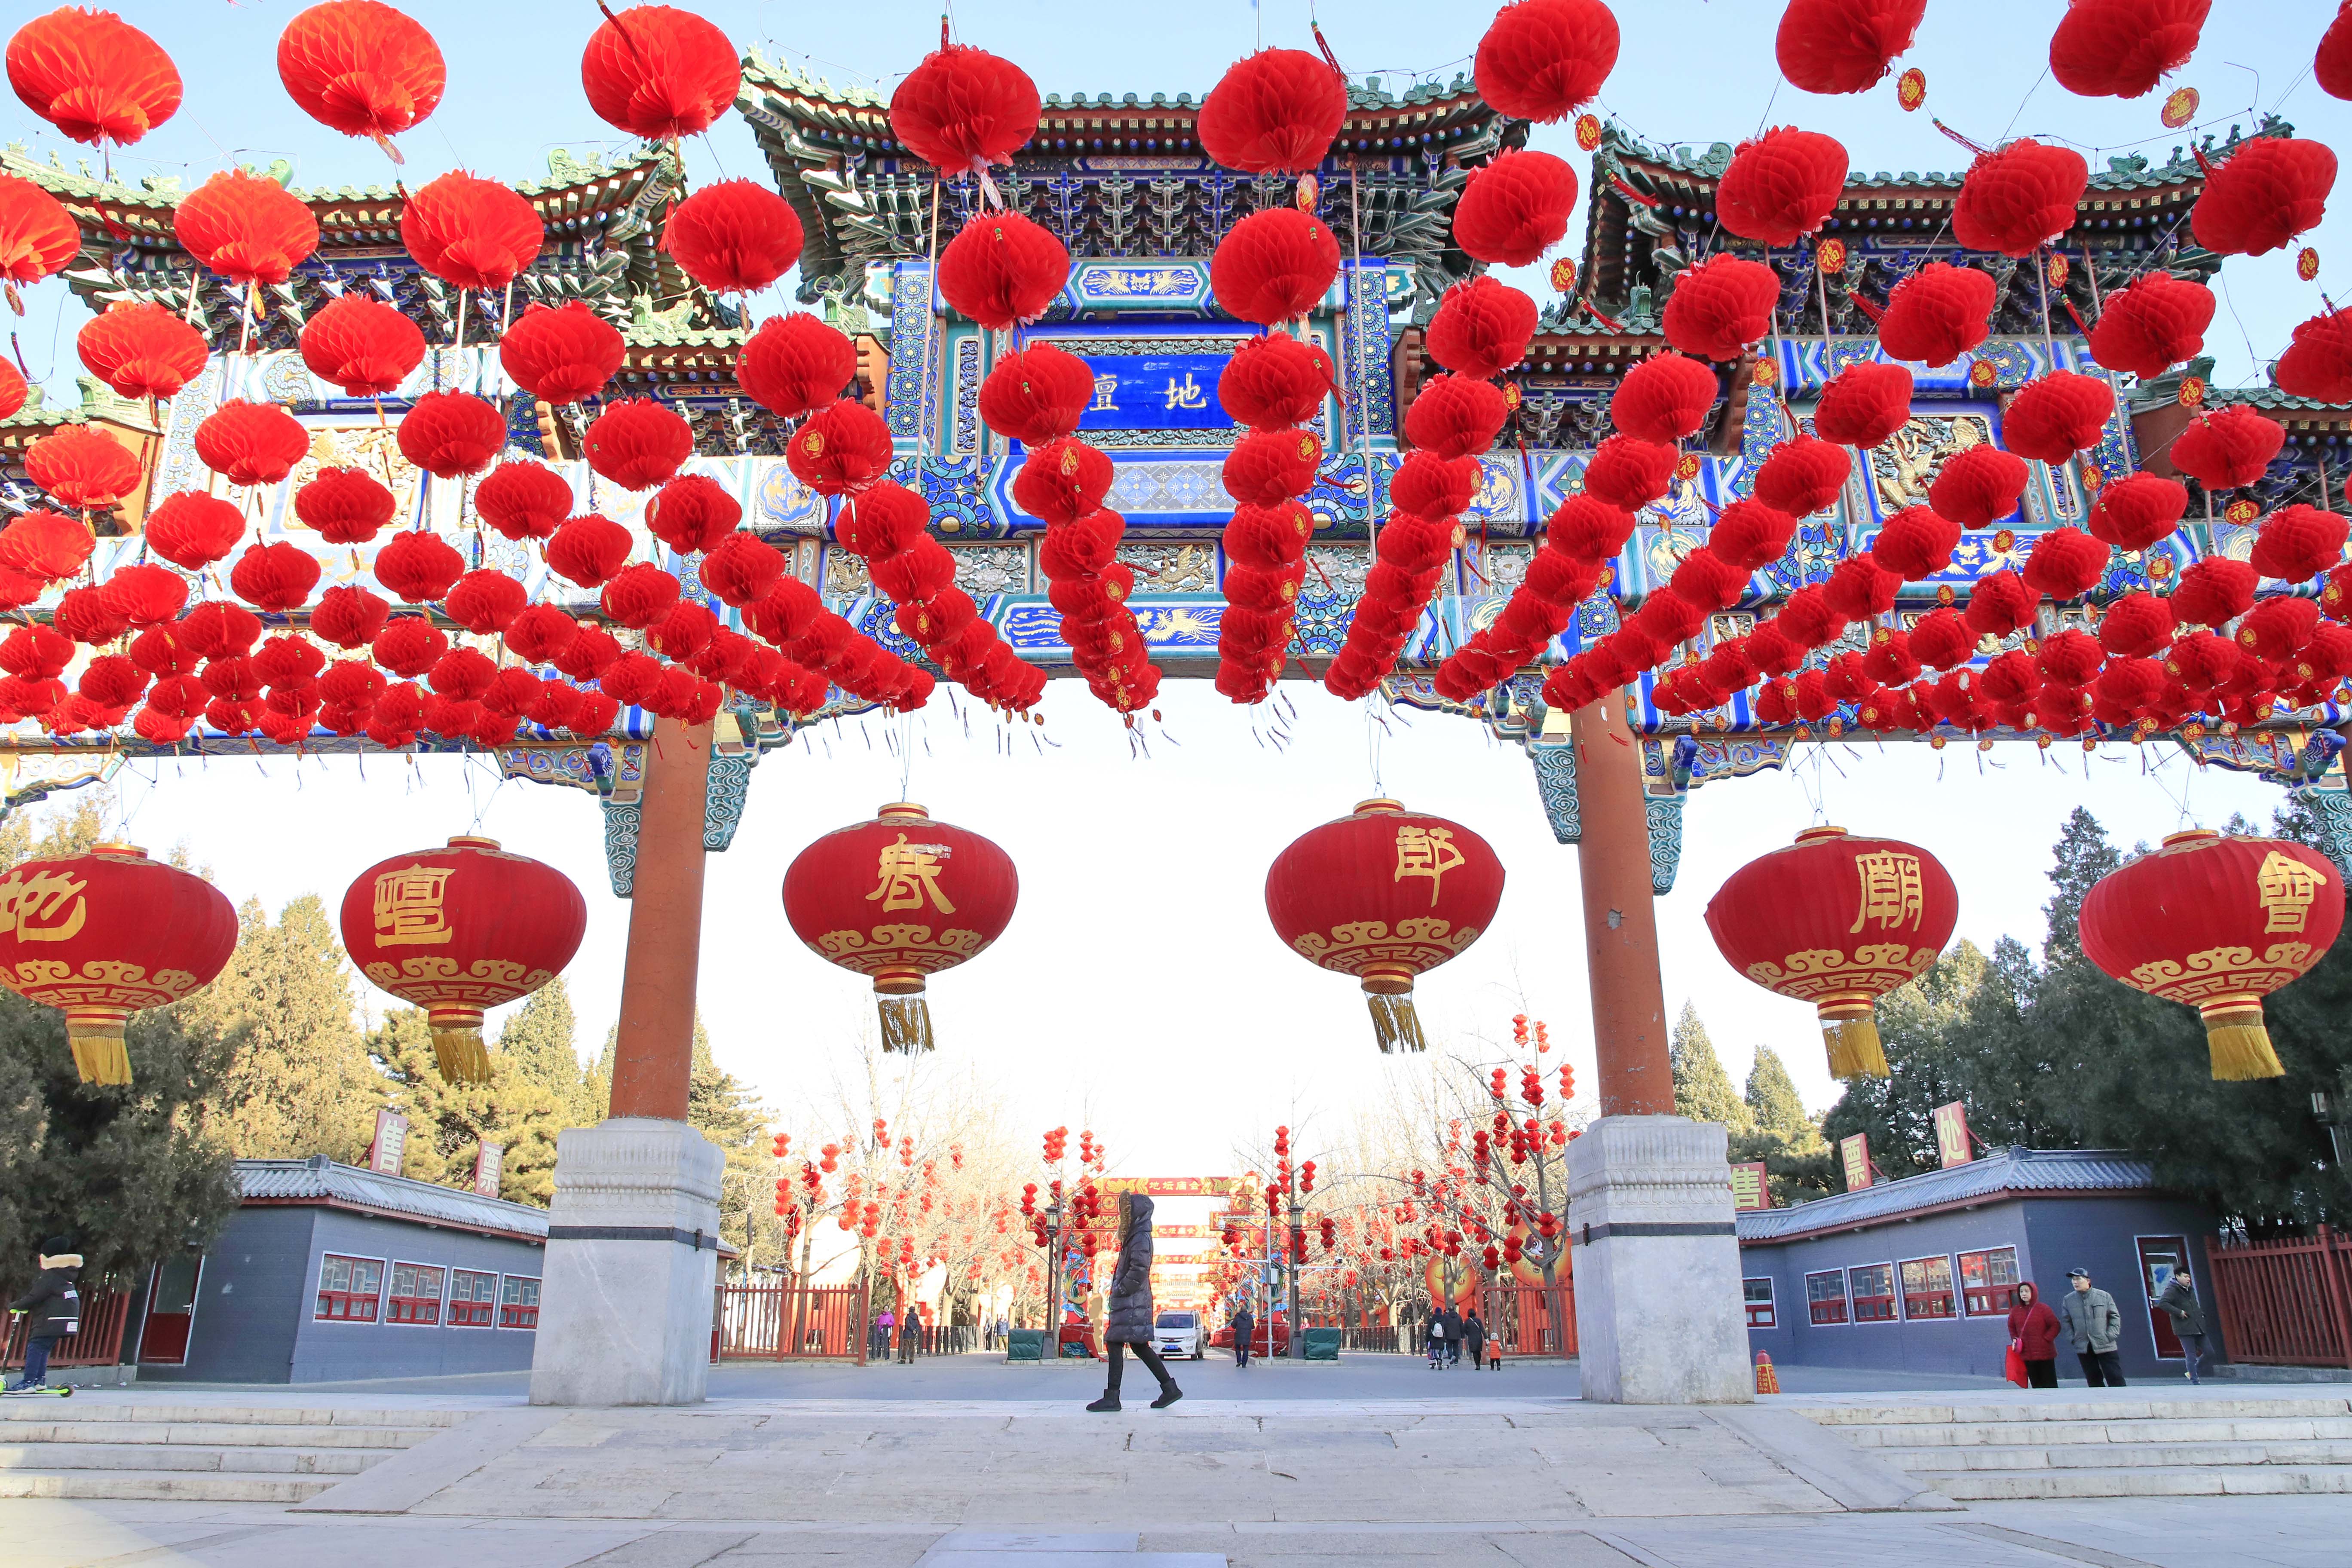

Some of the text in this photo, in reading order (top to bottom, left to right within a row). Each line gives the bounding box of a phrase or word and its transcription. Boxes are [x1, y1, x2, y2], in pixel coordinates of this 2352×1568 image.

[1578, 118, 1596, 145] 福
[1821, 244, 1839, 267] 福
[2302, 252, 2315, 273] 福
[1554, 262, 1572, 285] 福
[2052, 258, 2063, 280] 福
[2184, 382, 2199, 401] 福
[1064, 449, 1076, 469] 福
[1680, 458, 1695, 475] 福
[2086, 469, 2097, 485] 福
[2232, 503, 2251, 520] 福
[1687, 652, 1697, 664] 福
[1865, 709, 1874, 718] 福
[2142, 719, 2154, 729] 福
[2189, 725, 2200, 735] 福
[865, 833, 956, 914] 春
[1850, 849, 1923, 933] 廟
[2257, 851, 2326, 934] 會
[0, 870, 87, 943] 地
[378, 1118, 502, 1193] 售 票
[1728, 1107, 1966, 1209] 售 票 处
[1149, 1180, 1200, 1190] 地坛庙会
